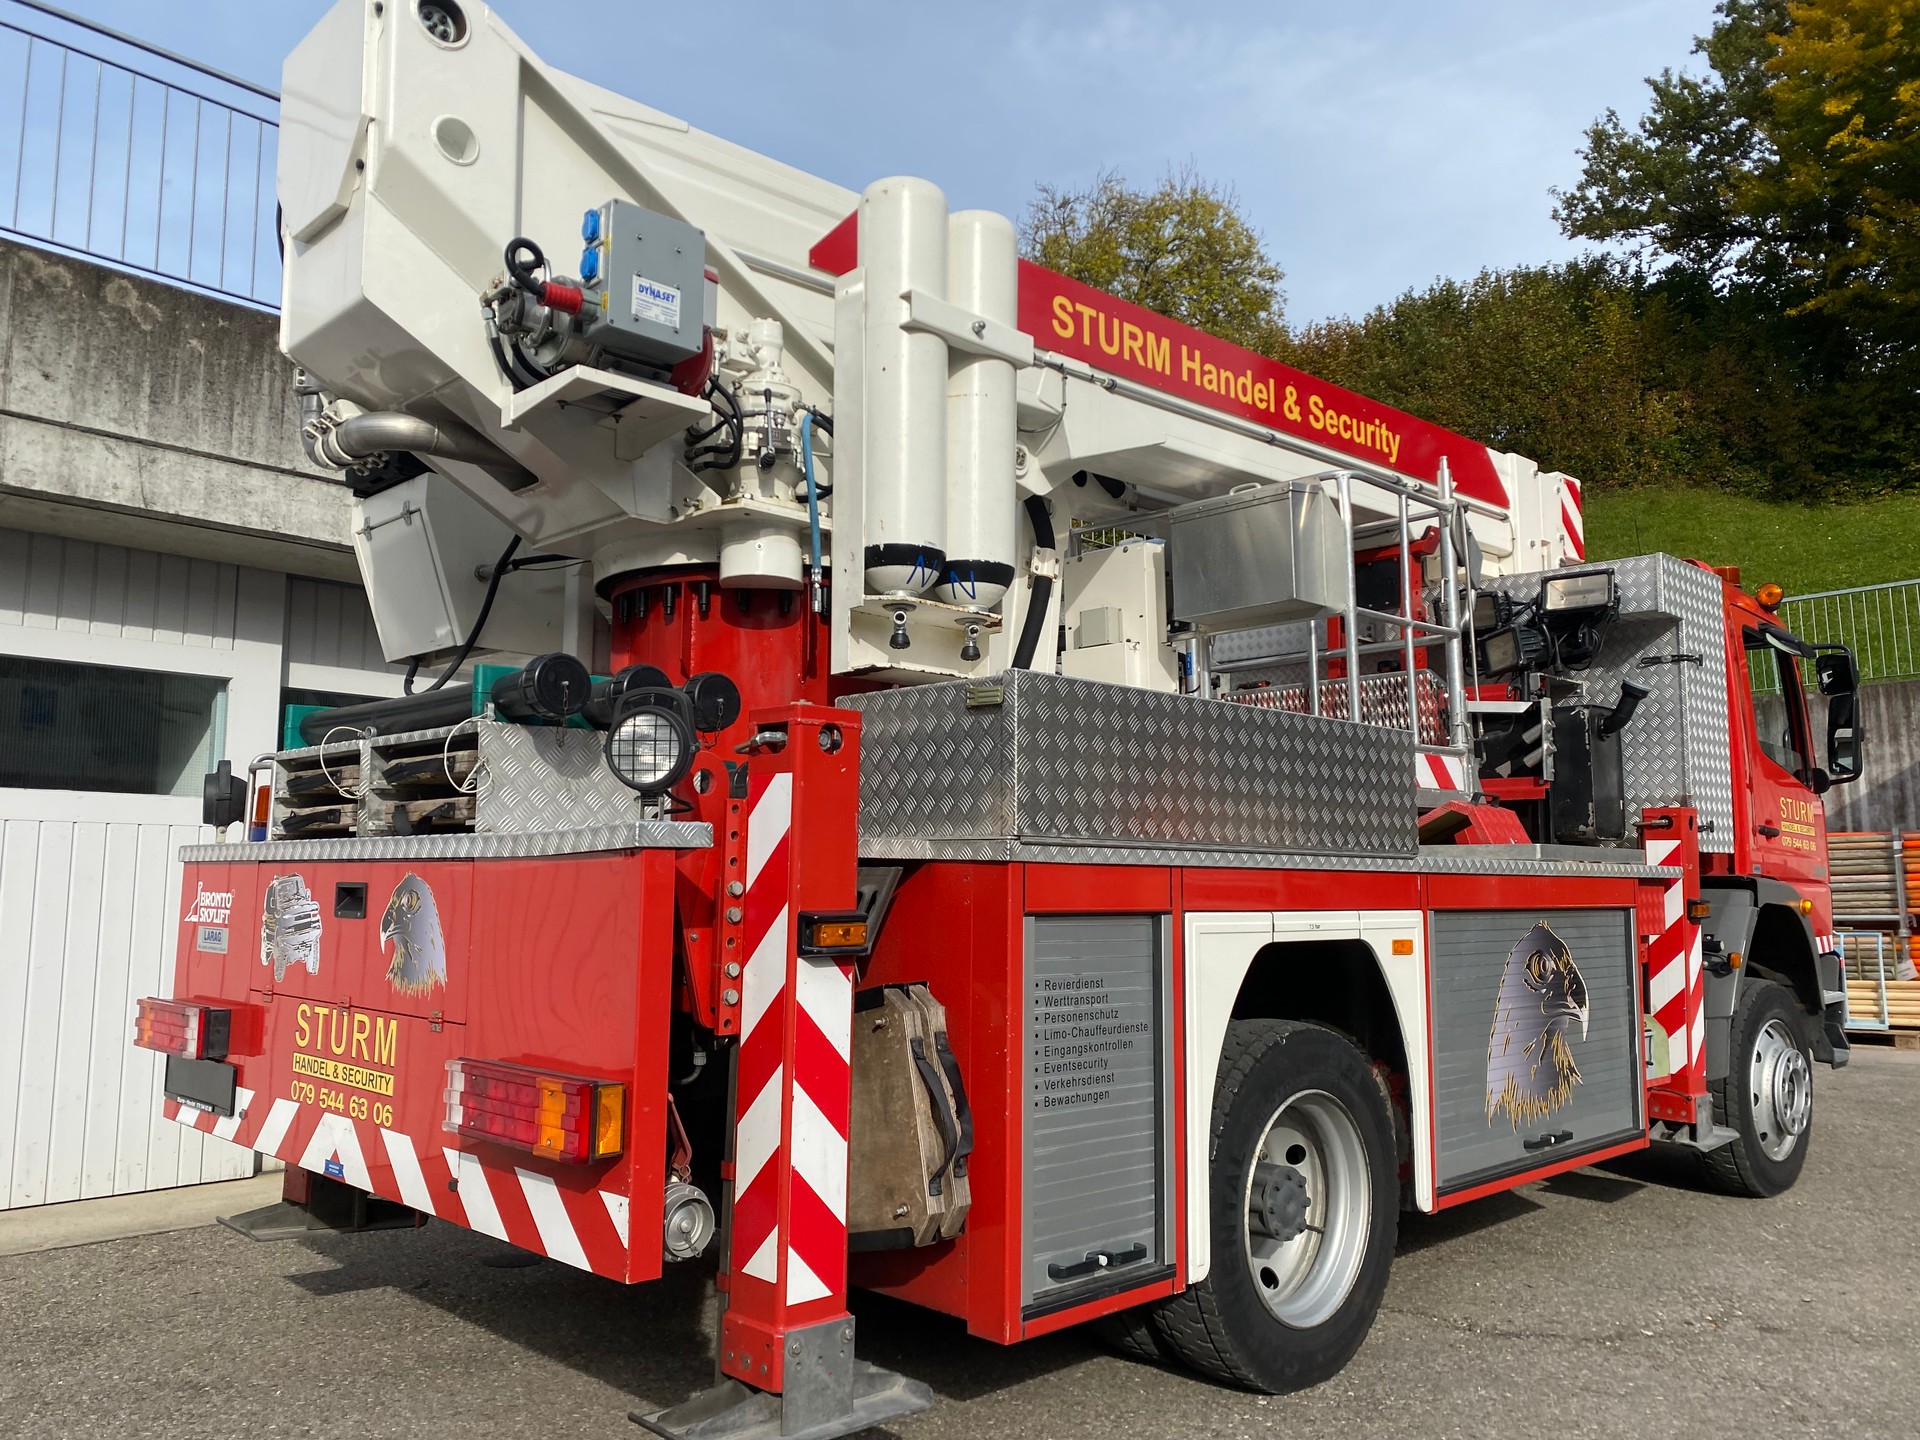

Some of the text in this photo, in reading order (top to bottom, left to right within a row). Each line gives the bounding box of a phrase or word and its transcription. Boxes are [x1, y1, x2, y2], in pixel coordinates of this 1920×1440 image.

[638, 283, 676, 303] DYNASET
[1052, 294, 1401, 464] STURM Handel & Security
[1780, 797, 1815, 823] STURM
[200, 891, 233, 908] BRONTO
[199, 907, 231, 924] SKYLIFT
[203, 930, 222, 943] LARAG
[1044, 978, 1104, 991] Revierdienst
[1044, 994, 1109, 1007] Werttransport
[1044, 1009, 1119, 1024] Personenschutz
[295, 1003, 398, 1068] STURM
[1044, 1022, 1149, 1041] Limo-Chauffeurdienste
[1044, 1039, 1134, 1058] Eingangskontrollen
[294, 1055, 391, 1092] HANDEL & SECURITY
[1044, 1057, 1109, 1074] Eventsecurity
[1044, 1072, 1115, 1091] Verkehrsdienst
[291, 1080, 393, 1127] 079 544 63 06
[1044, 1090, 1110, 1108] Bewachungen
